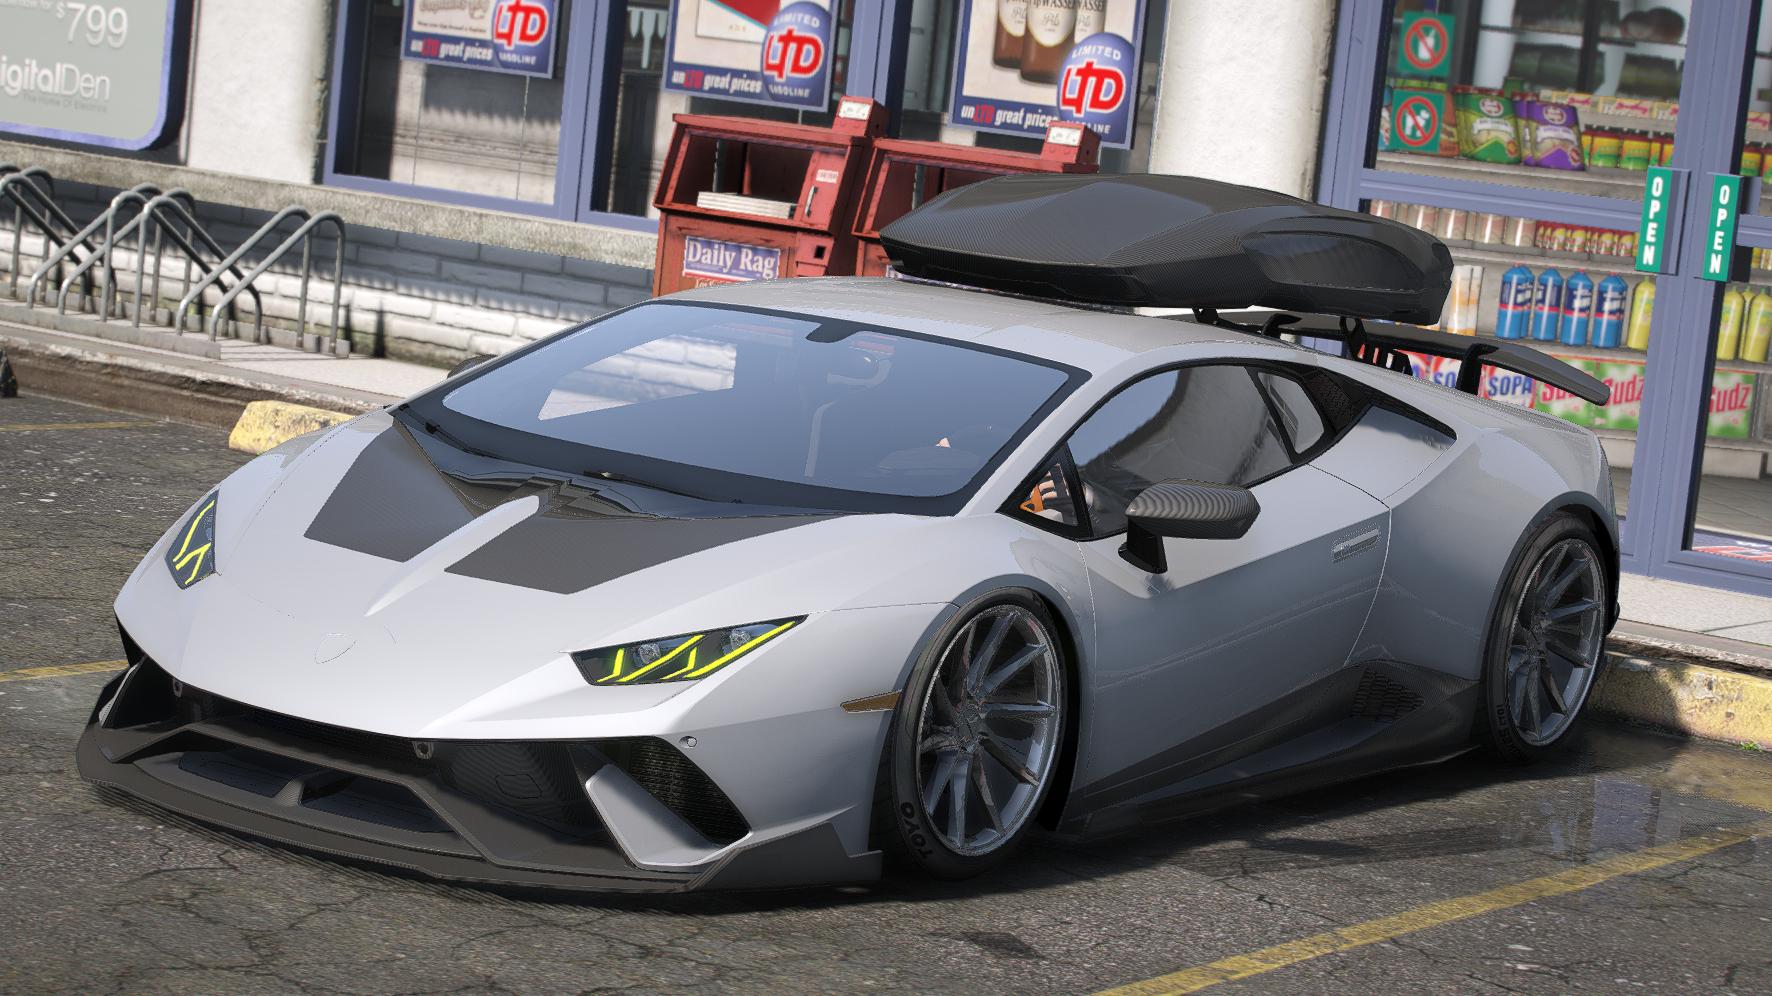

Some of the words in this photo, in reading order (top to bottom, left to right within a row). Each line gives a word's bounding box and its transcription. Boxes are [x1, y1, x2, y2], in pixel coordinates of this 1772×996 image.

[56, 1, 128, 48] $799
[773, 12, 820, 28] LIMITED
[440, 42, 464, 58] great
[463, 42, 493, 61] prices
[763, 25, 824, 82] LTD
[1072, 44, 1122, 61] LIMITED
[703, 73, 730, 91] great
[729, 73, 763, 94] prices
[1060, 59, 1126, 117] LTD
[961, 104, 996, 123] unLTD
[994, 108, 1024, 126] great
[1642, 175, 1664, 266] OPEN
[1709, 184, 1731, 274] OPEN
[687, 239, 737, 273] Daily
[739, 247, 776, 280] Rag
[1488, 374, 1533, 397] SOPA
